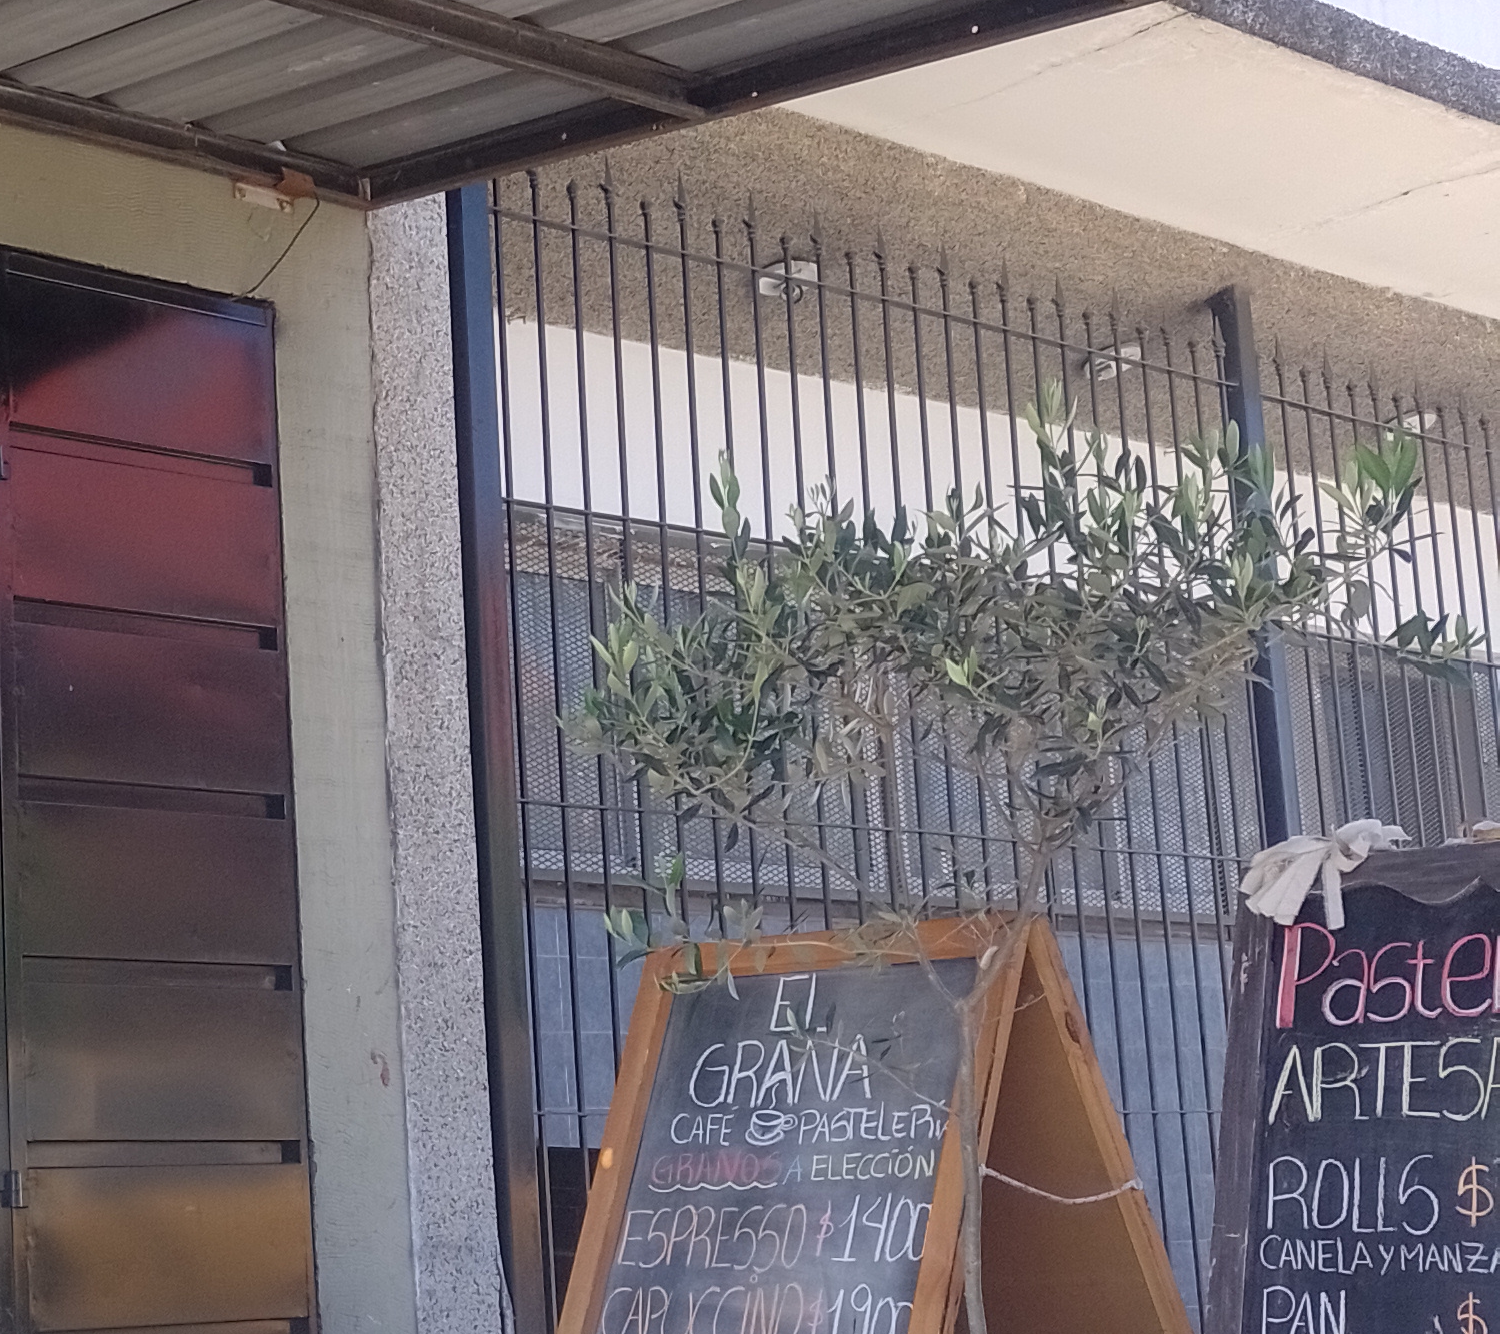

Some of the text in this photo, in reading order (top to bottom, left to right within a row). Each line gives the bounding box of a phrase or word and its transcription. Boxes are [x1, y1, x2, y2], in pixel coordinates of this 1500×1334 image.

[688, 1033, 873, 1109] GRANA
[670, 1106, 740, 1147] CAFÉ
[1266, 1154, 1441, 1237] ROLLS
[616, 1203, 808, 1273] ESPRESSO
[1259, 1234, 1374, 1276] CANELA
